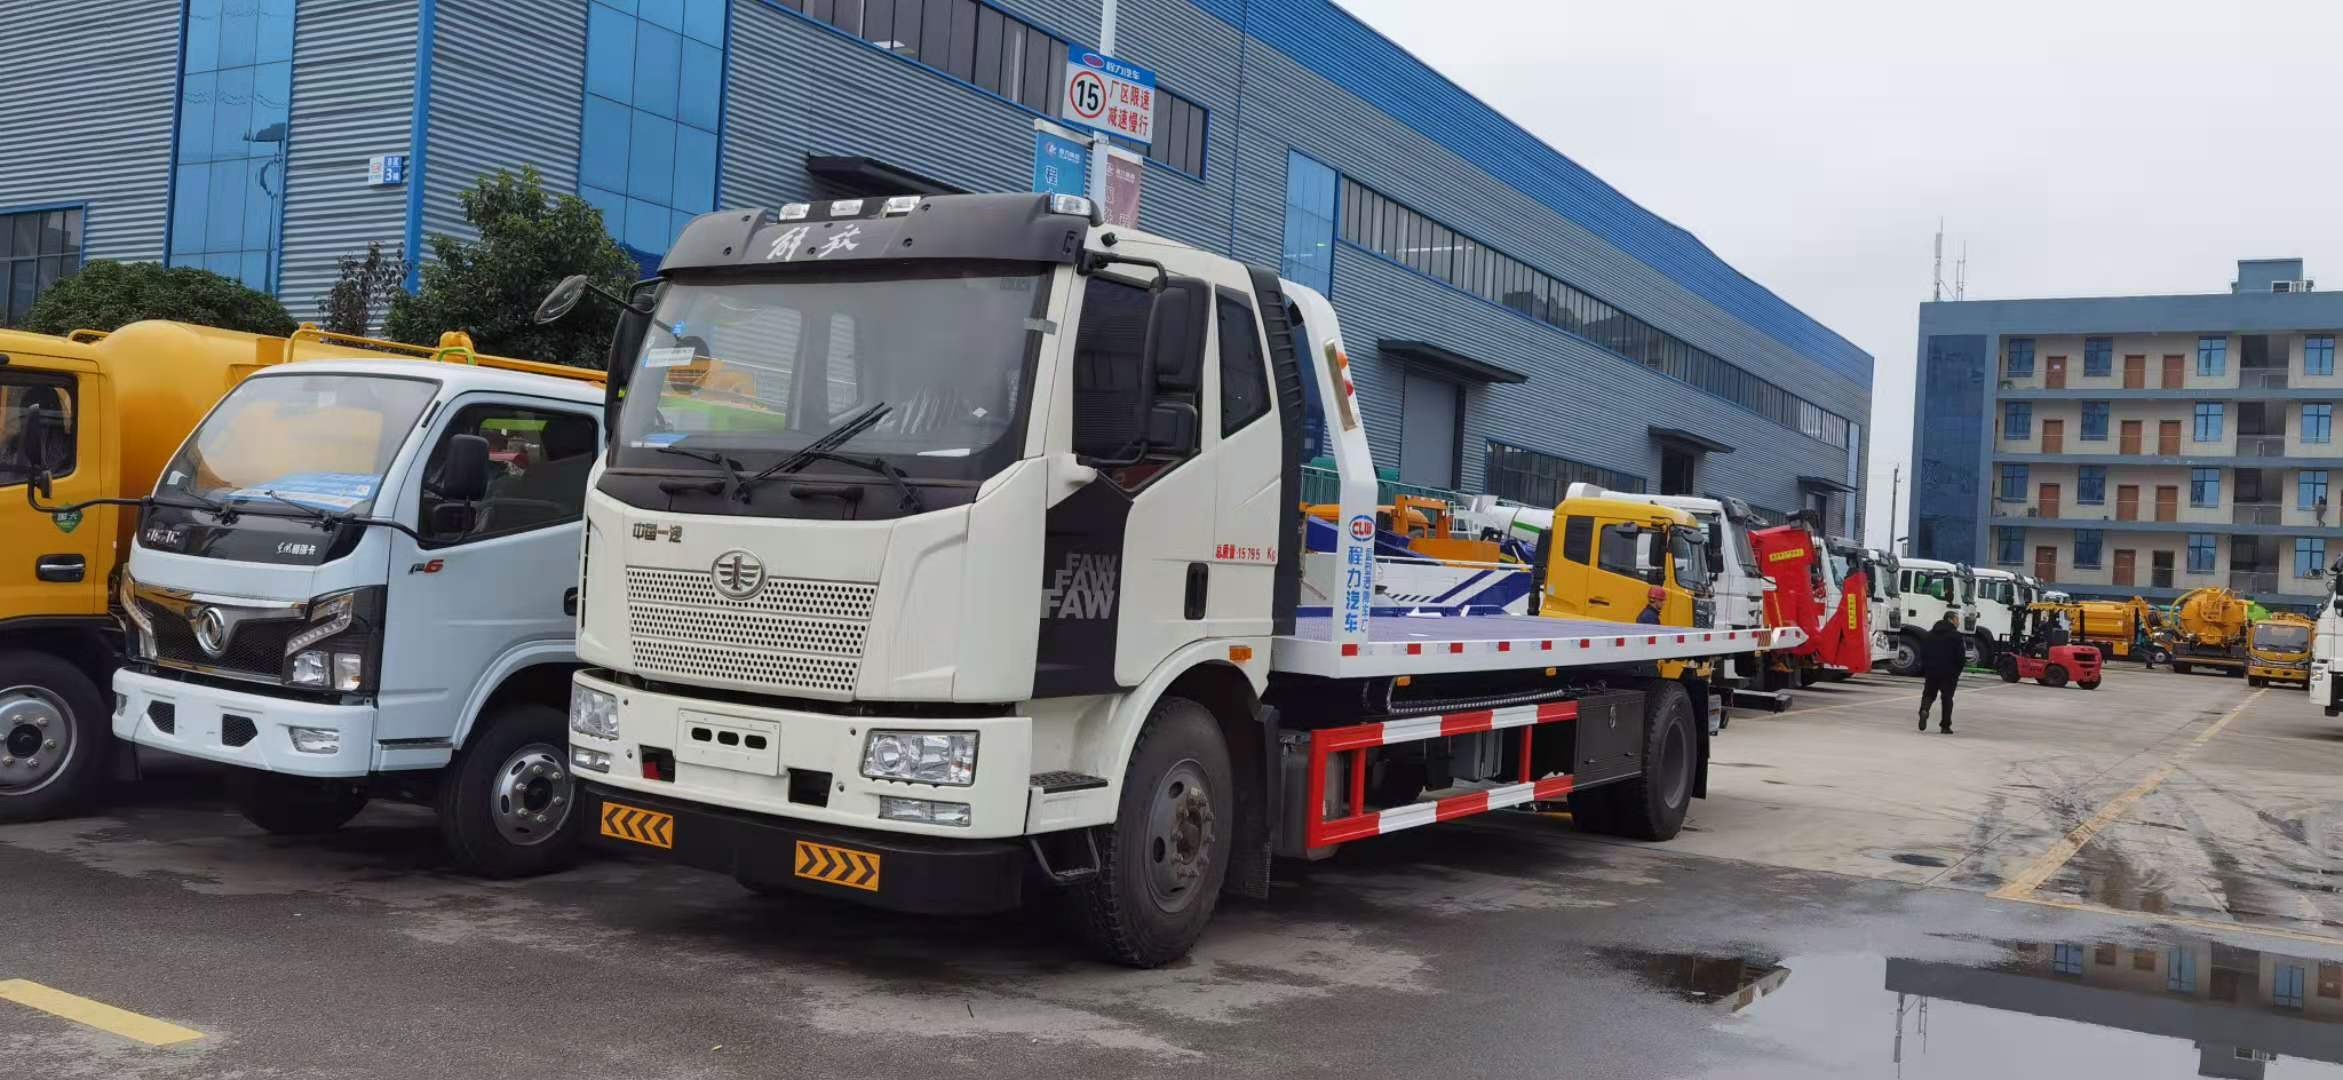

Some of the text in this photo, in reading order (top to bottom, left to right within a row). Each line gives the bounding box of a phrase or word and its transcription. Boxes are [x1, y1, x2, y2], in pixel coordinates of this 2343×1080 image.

[1077, 80, 1099, 111] 15
[1110, 80, 1150, 111] 厂区限速
[1107, 106, 1149, 137] 减速慢行
[632, 523, 683, 544] 中国一汽
[1352, 520, 1373, 536] CLW
[1065, 553, 1118, 573] FAW
[1055, 570, 1117, 595] FAW
[1344, 545, 1364, 633] 程力汽车
[1040, 588, 1116, 619] FAW
